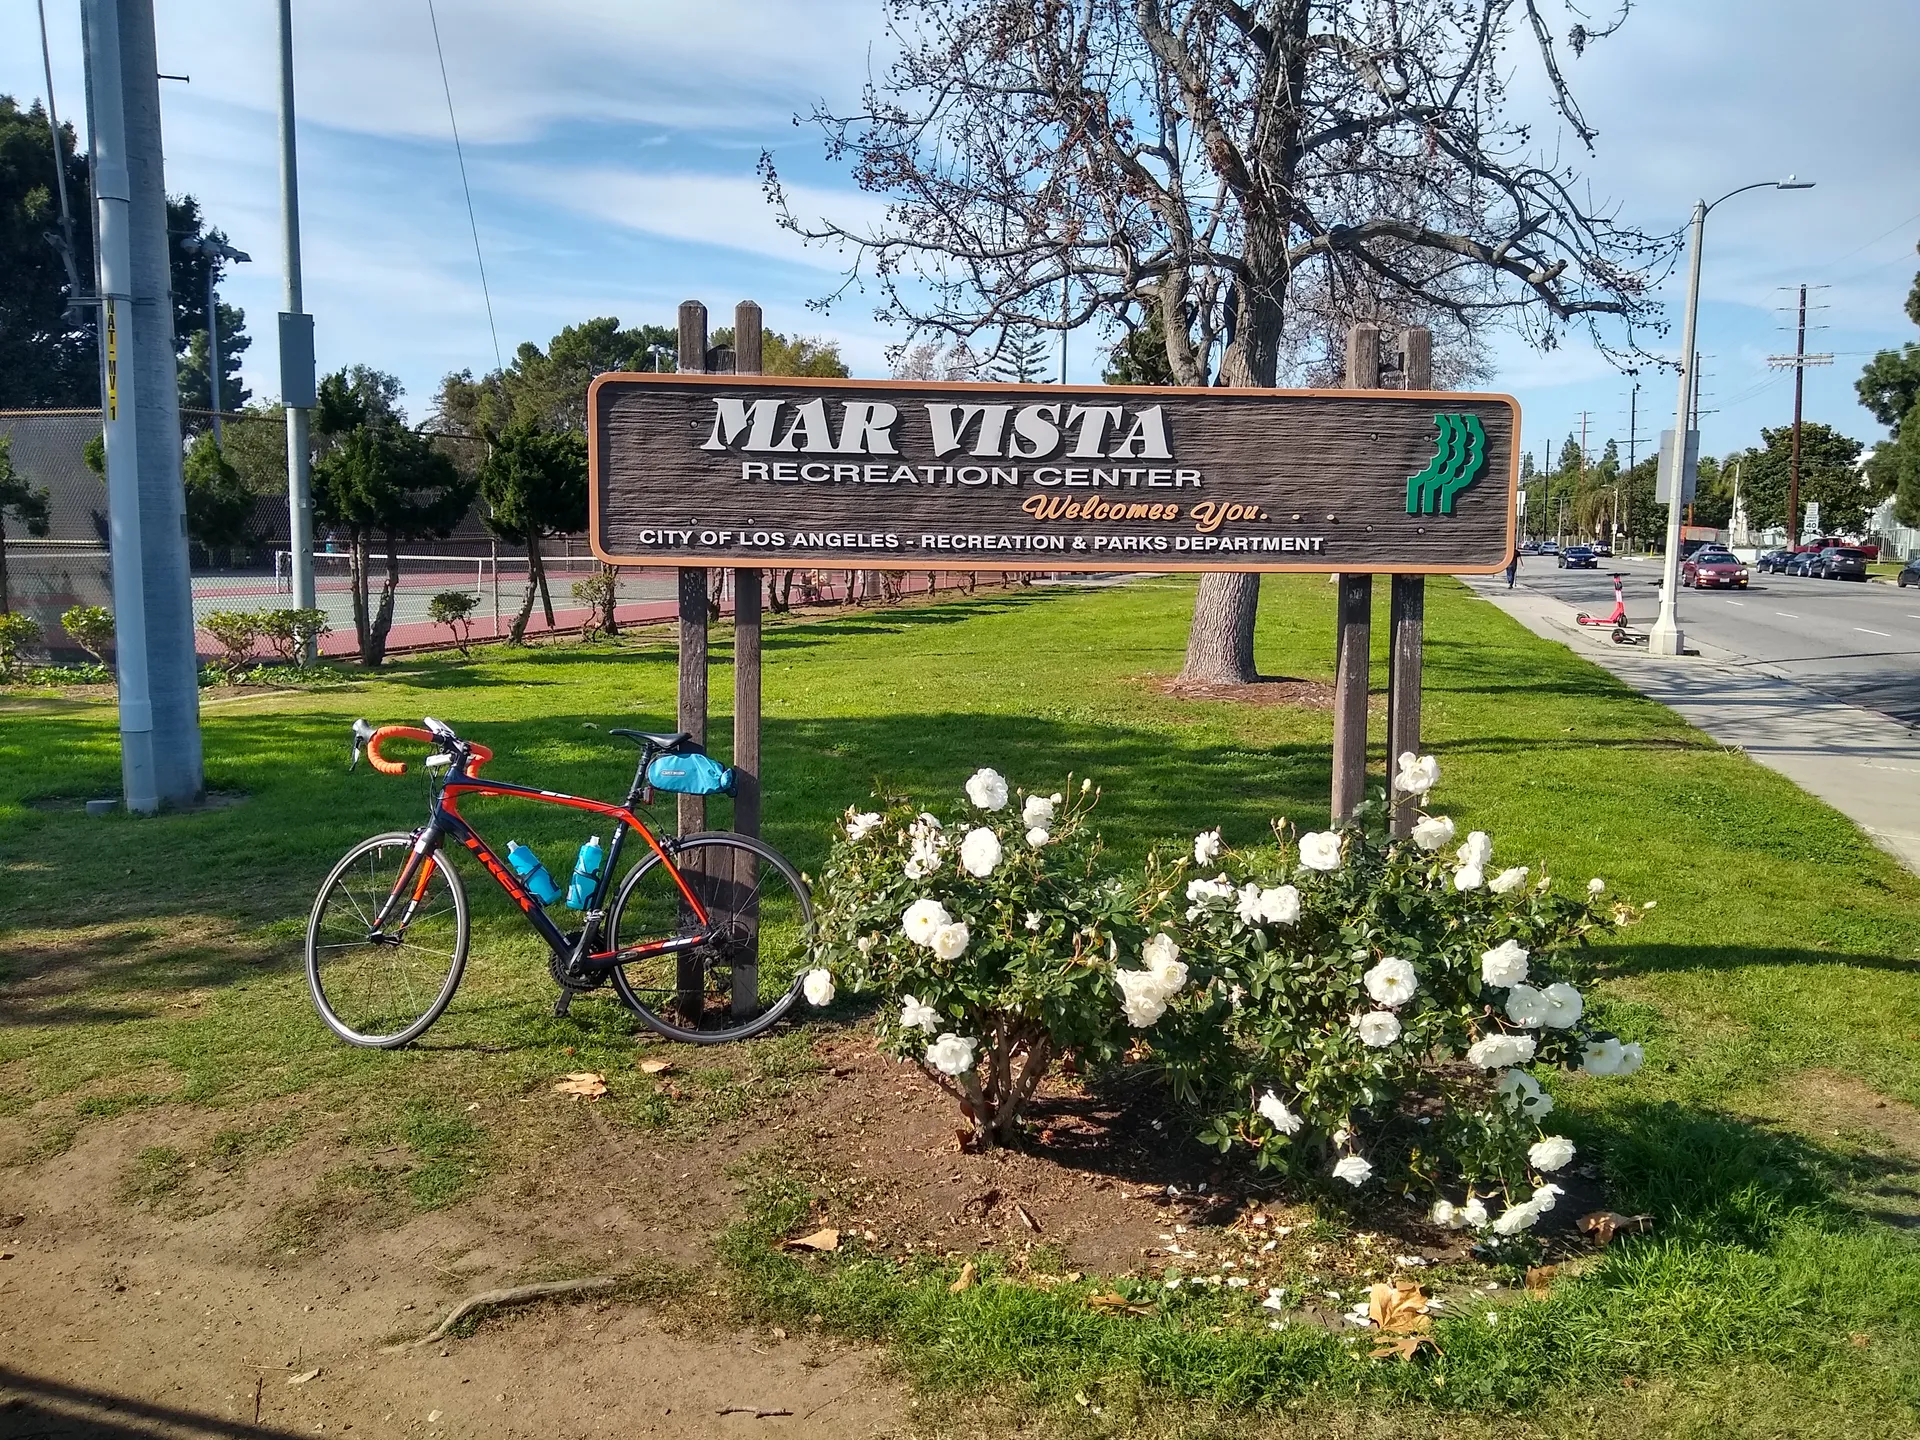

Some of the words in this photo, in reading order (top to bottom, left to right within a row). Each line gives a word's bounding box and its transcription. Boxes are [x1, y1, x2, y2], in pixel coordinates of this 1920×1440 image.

[700, 397, 899, 454] MAR
[924, 403, 1173, 459] VISTA
[741, 461, 1018, 486] RECREATION
[1033, 468, 1202, 488] CENTER
[1021, 494, 1179, 521] Welcomes
[639, 529, 693, 545] CITY
[703, 530, 732, 545] OF
[740, 531, 786, 547] LOS
[792, 532, 899, 548] ANGELES
[921, 534, 1065, 549] RECREATION
[1071, 535, 1087, 550] &
[1094, 535, 1168, 550] PARKS
[1175, 536, 1324, 551] DEPARTMENT
[465, 831, 536, 912] TREK
